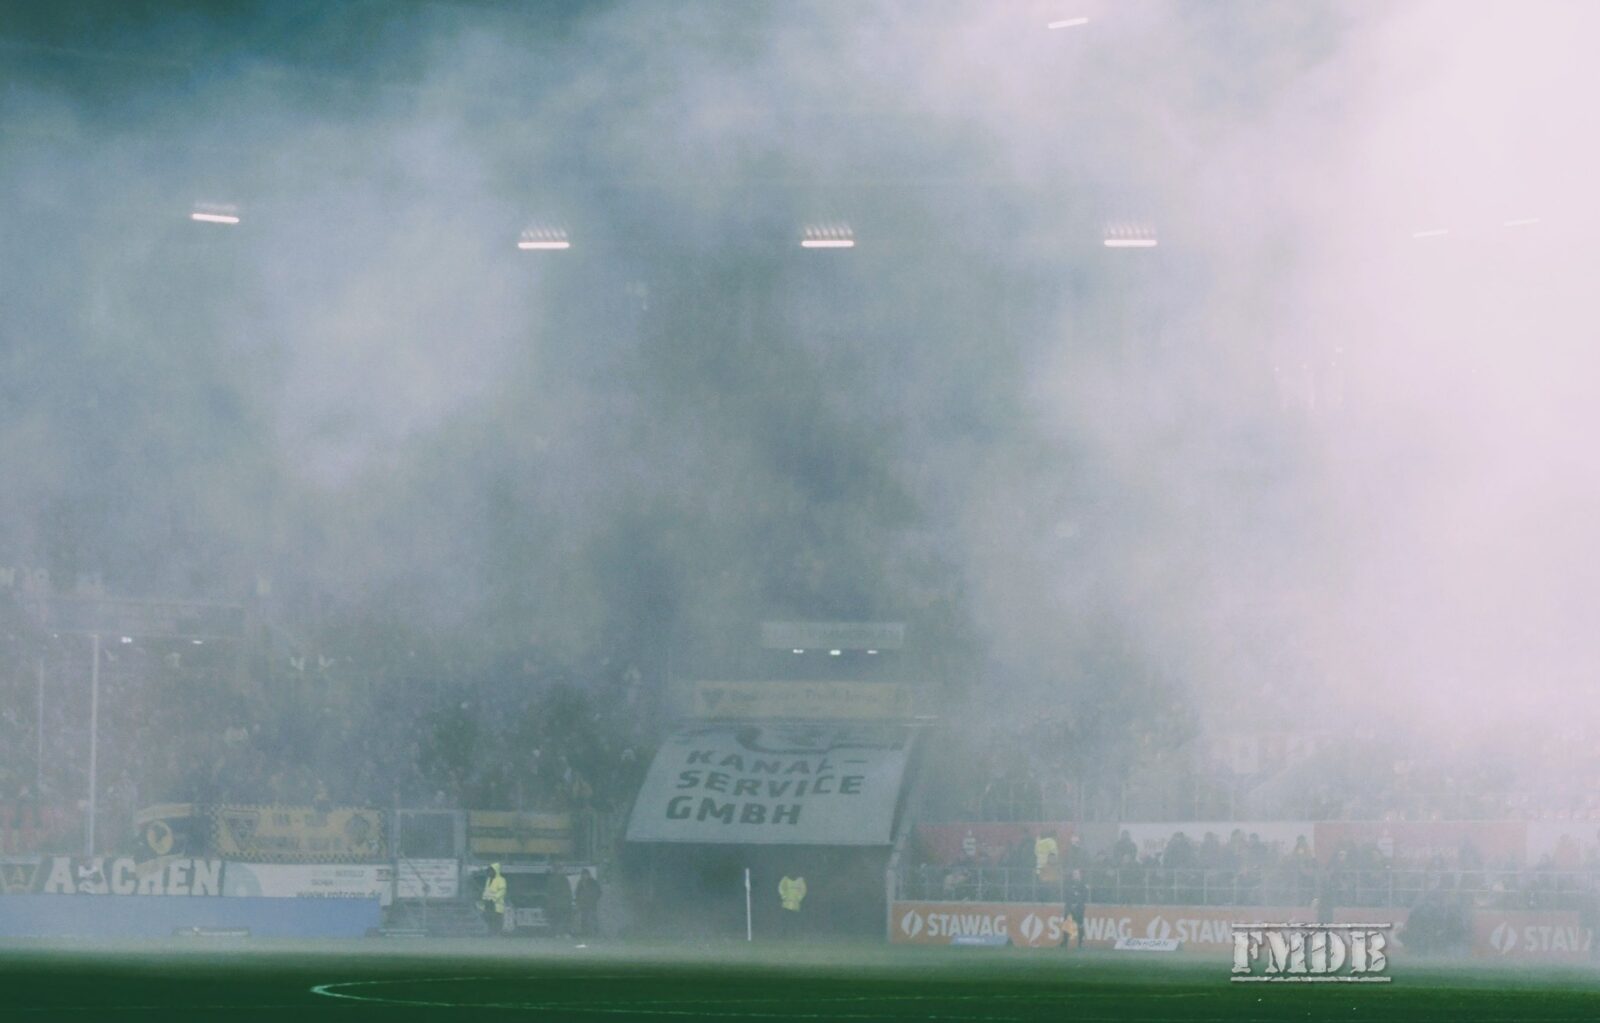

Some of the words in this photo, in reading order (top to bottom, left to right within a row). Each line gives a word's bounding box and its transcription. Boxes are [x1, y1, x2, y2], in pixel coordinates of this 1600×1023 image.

[676, 770, 865, 799] SERVICE
[665, 795, 804, 826] GMBH
[927, 914, 1008, 937] STAWAG
[1047, 915, 1133, 941] SWAG
[1175, 918, 1233, 944] STAW
